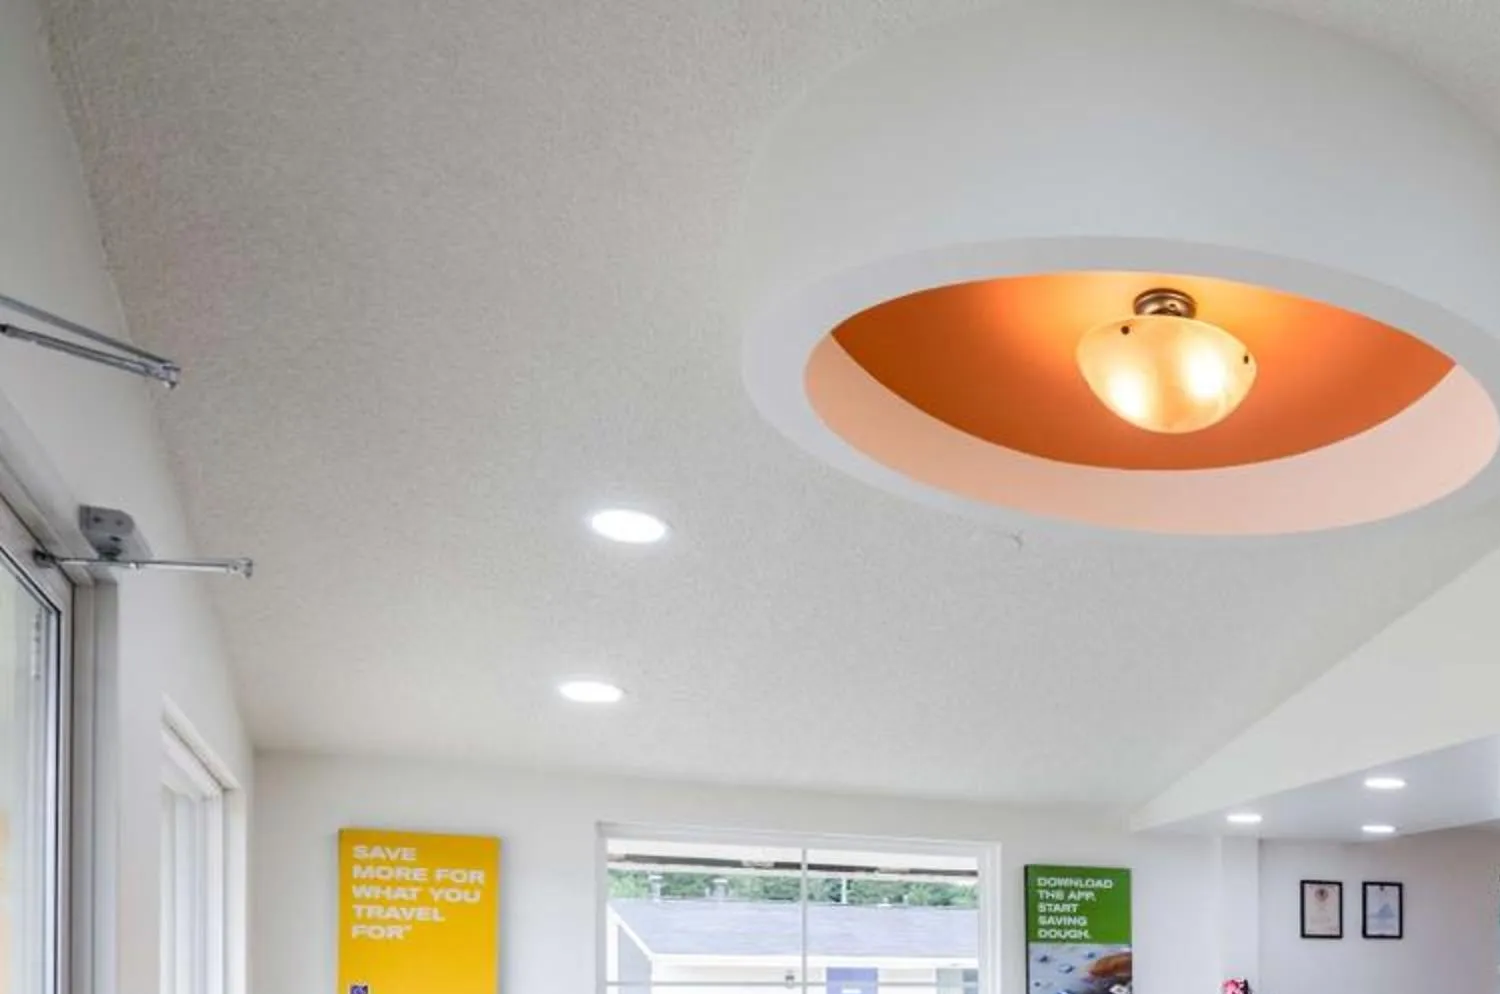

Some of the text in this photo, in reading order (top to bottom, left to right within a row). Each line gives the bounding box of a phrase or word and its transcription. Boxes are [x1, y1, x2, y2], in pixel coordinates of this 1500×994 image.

[352, 845, 417, 861] SAVE
[352, 865, 486, 884] MORE FOR
[1037, 877, 1113, 889] DOWNLOAD
[352, 885, 481, 903] WHAT YOU
[1037, 889, 1065, 901] THE
[352, 904, 446, 922] TRAVEL
[1038, 903, 1079, 913] START
[1038, 915, 1088, 927] SAVING
